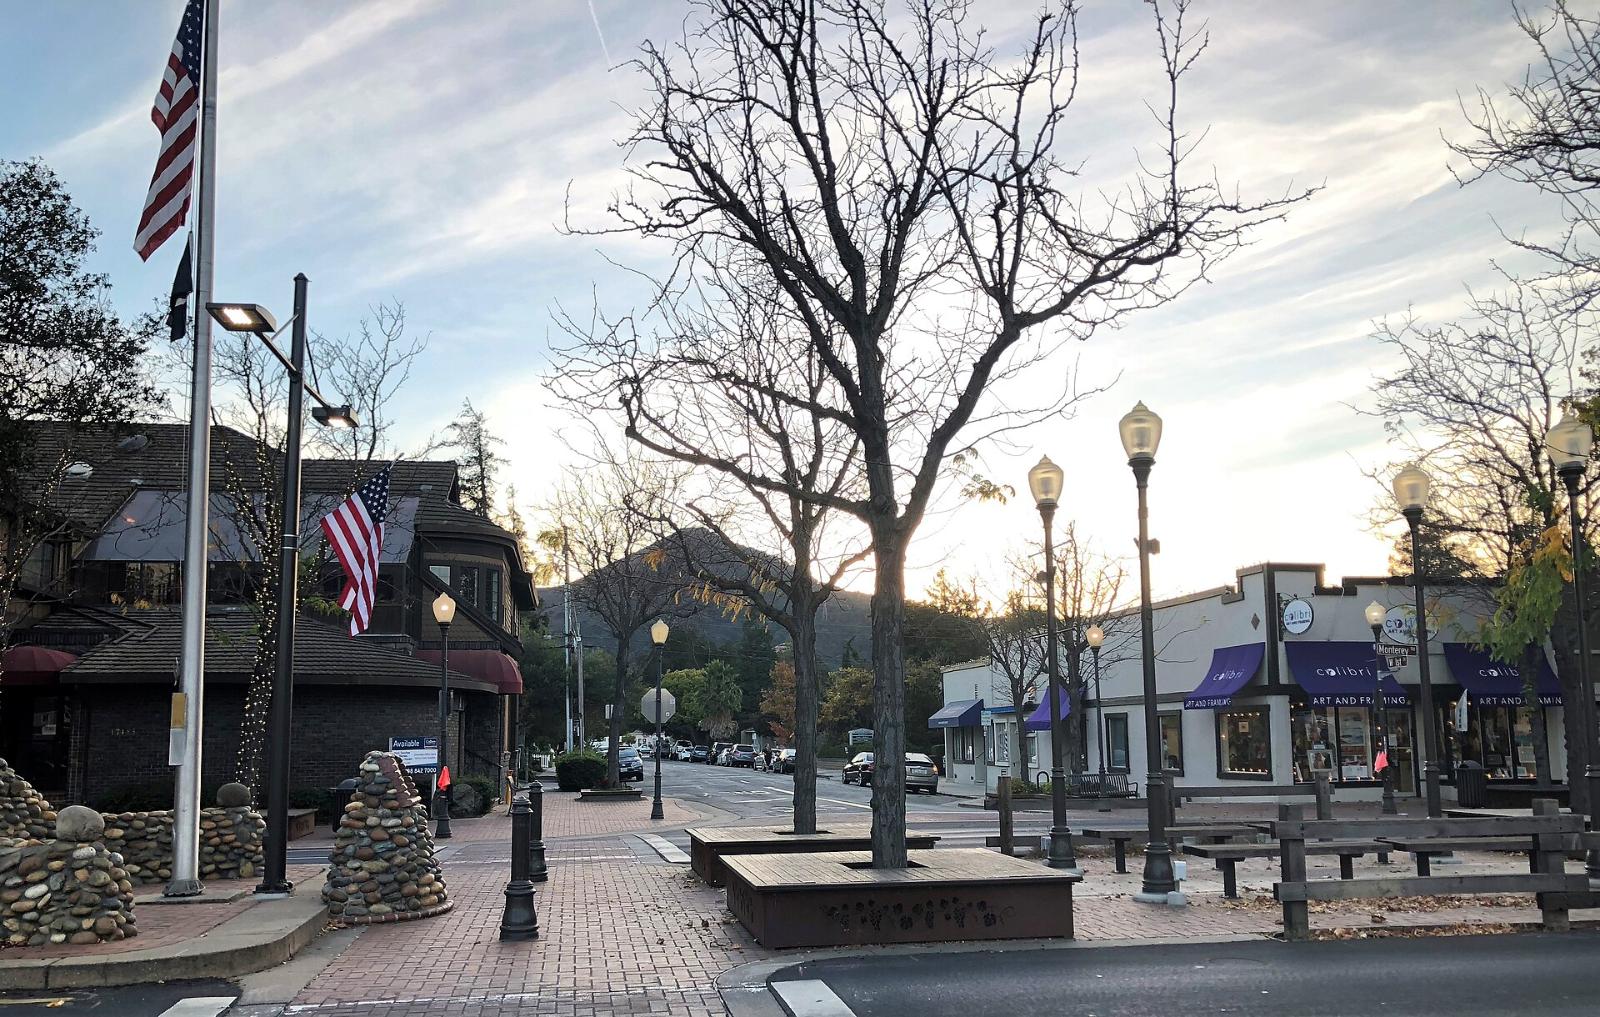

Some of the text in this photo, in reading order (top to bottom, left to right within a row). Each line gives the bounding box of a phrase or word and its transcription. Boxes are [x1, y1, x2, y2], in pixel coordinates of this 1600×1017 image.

[1285, 609, 1311, 621] colibri
[1378, 644, 1409, 655] Monterey
[1212, 669, 1244, 681] colibri
[1316, 666, 1372, 677] colibri
[1479, 666, 1520, 677] colib
[1185, 700, 1195, 708] ART
[1195, 699, 1207, 708] AND
[1313, 696, 1332, 705] ART
[1335, 696, 1357, 705] AND
[1479, 696, 1498, 705] ART
[1501, 696, 1522, 705] AND
[393, 739, 420, 747] Available
